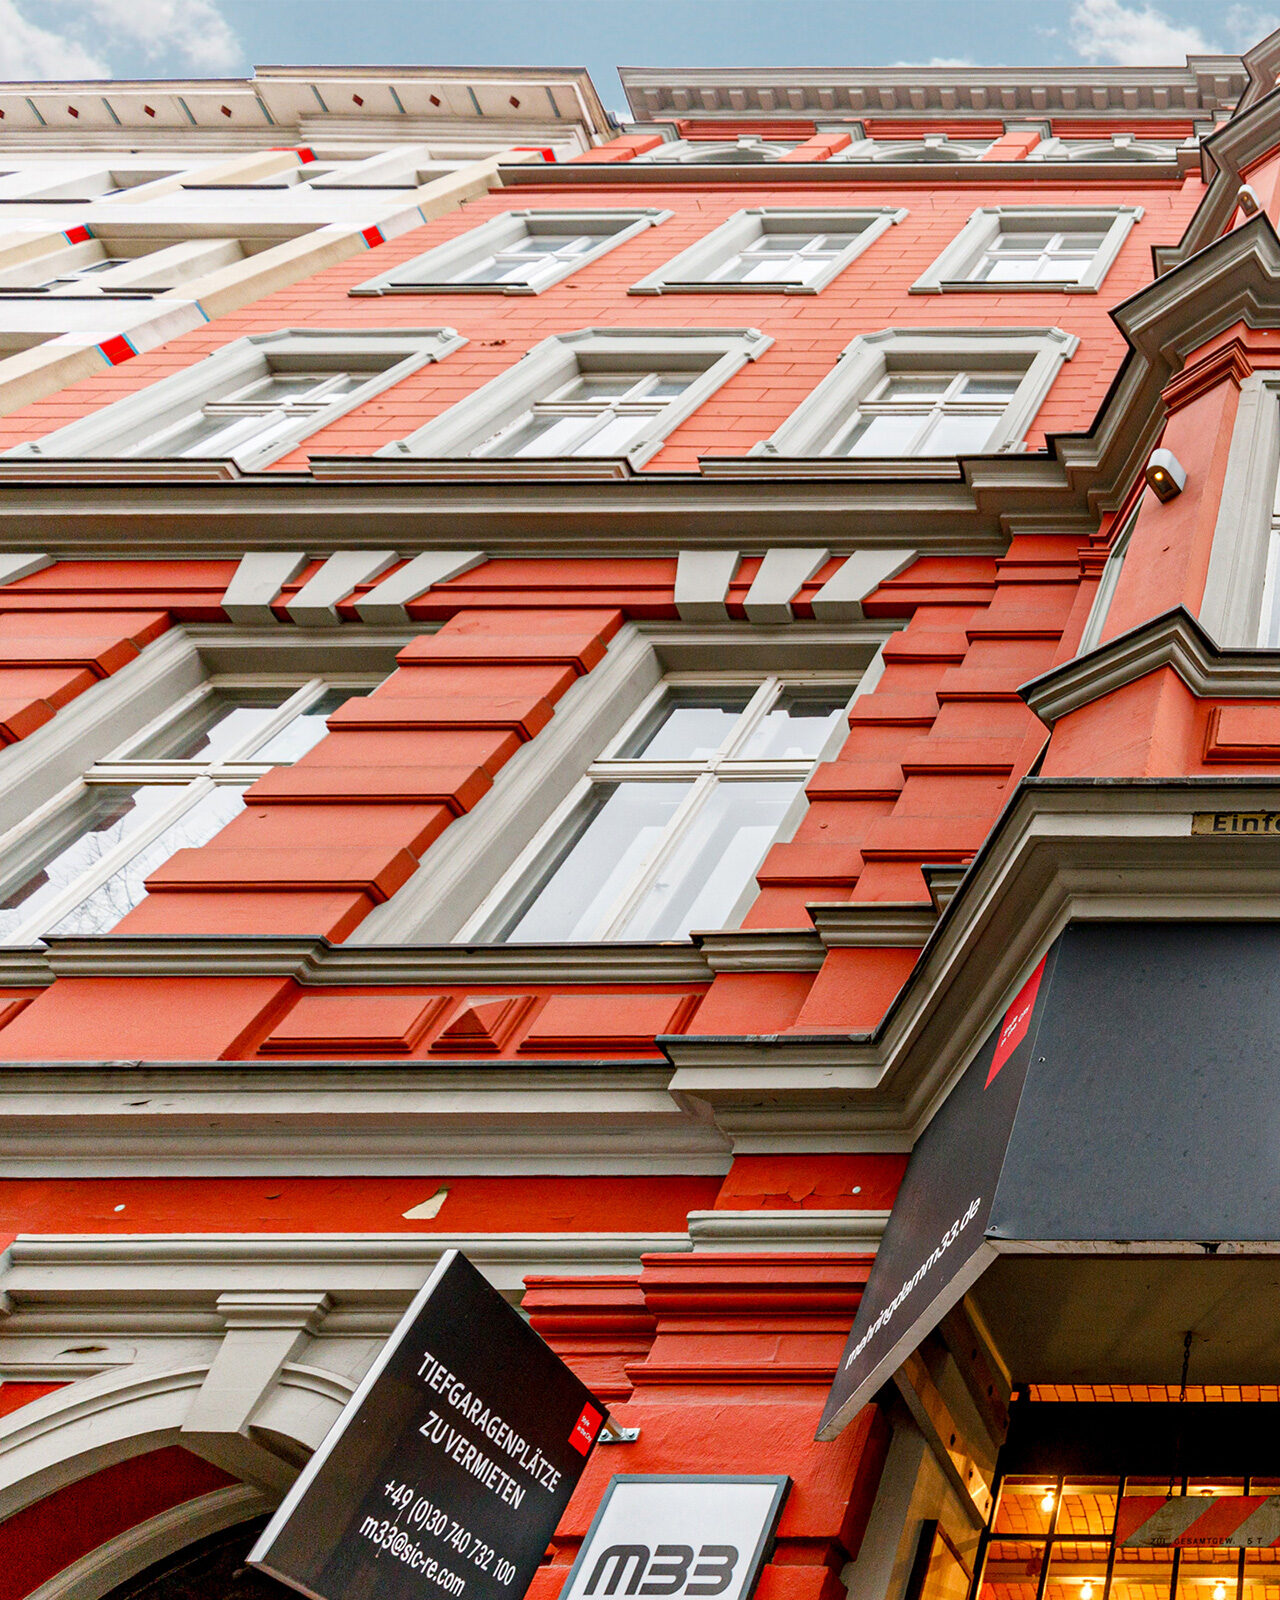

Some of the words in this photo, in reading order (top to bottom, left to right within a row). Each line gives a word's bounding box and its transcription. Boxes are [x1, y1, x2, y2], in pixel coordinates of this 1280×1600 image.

[417, 1351, 562, 1493] TIEFGARAGENPLÄTZE
[419, 1410, 449, 1444] ZU
[444, 1429, 526, 1510] VERMIETEN
[359, 1516, 466, 1597] m33@sic-re.com
[384, 1479, 414, 1510] +49
[407, 1497, 448, 1536] (0)30
[443, 1522, 472, 1553] 740
[467, 1539, 495, 1571] 732
[492, 1557, 516, 1586] 100
